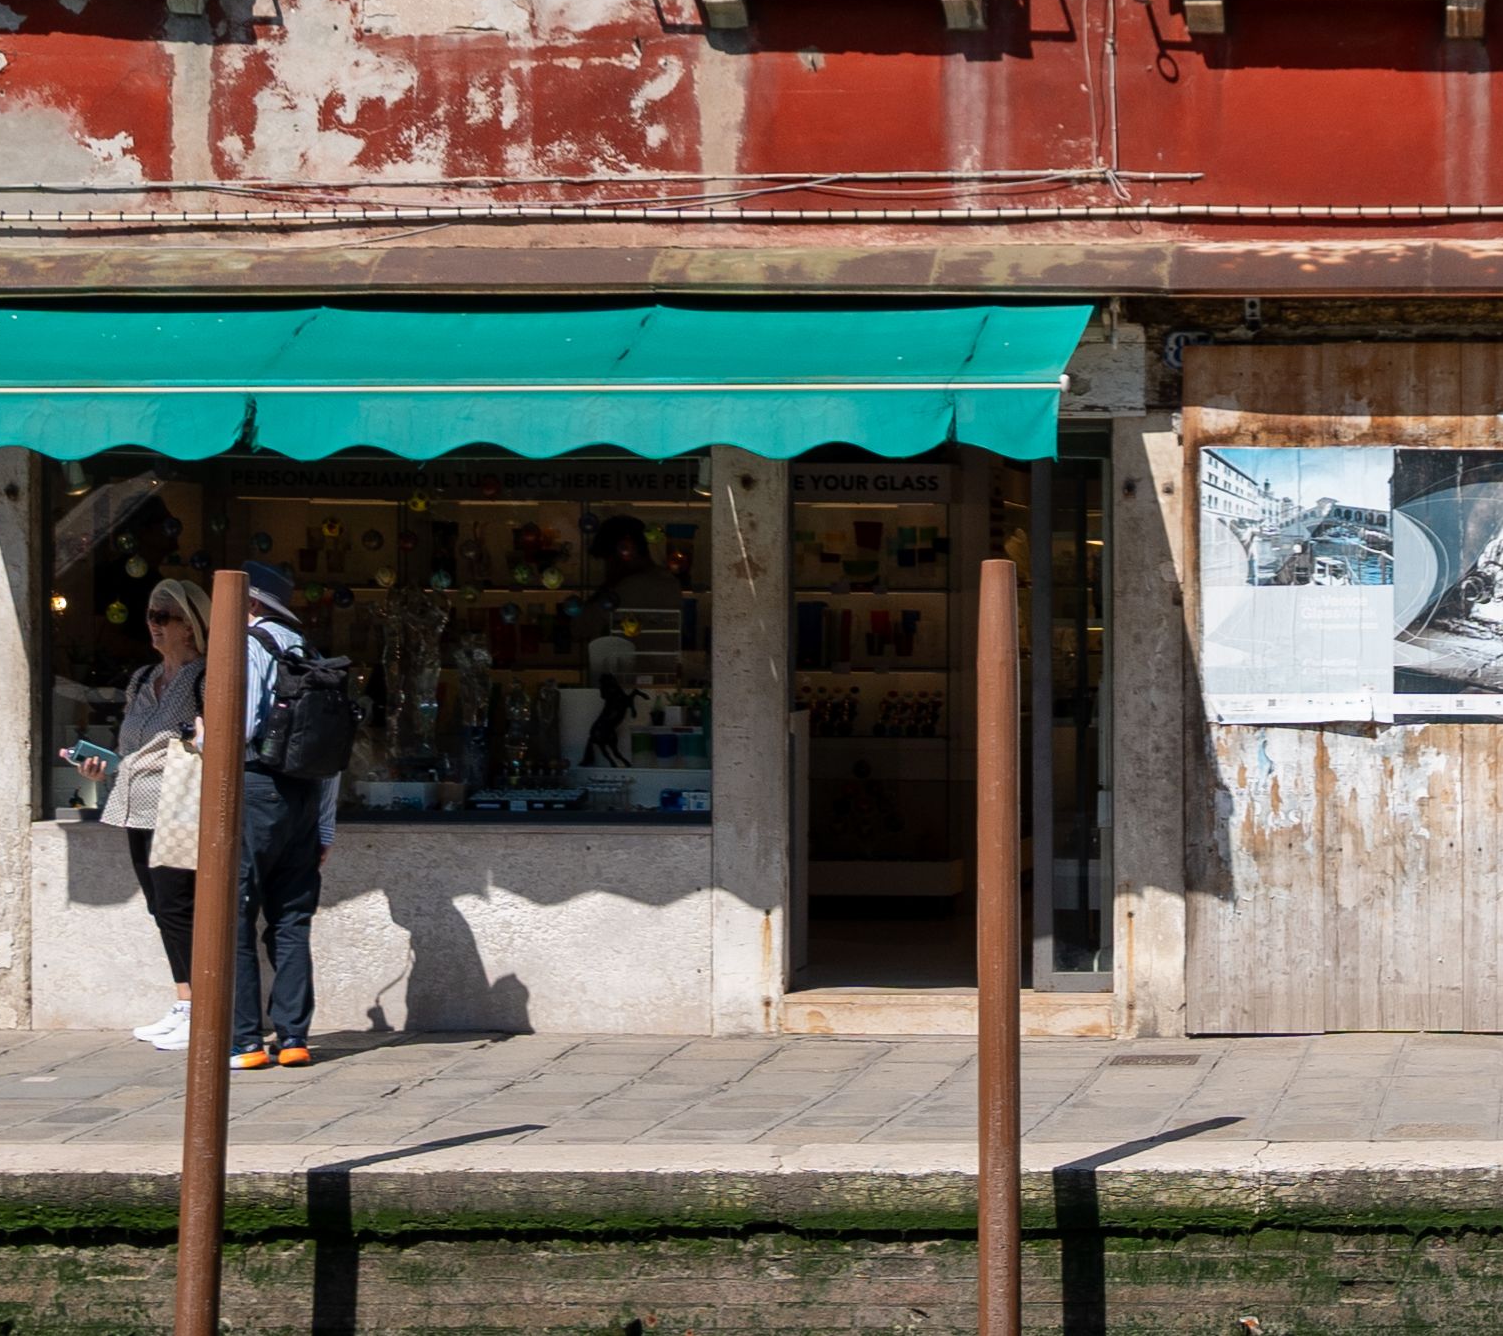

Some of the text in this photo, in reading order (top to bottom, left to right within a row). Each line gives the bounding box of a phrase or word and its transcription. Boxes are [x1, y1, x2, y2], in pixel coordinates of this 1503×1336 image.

[231, 470, 427, 488] PERSONALIZZIAMO
[433, 471, 449, 488] IL
[504, 472, 610, 489] BICCHIERE
[625, 473, 657, 489] WE
[810, 475, 867, 491] YOUR
[874, 475, 938, 491] GLASS
